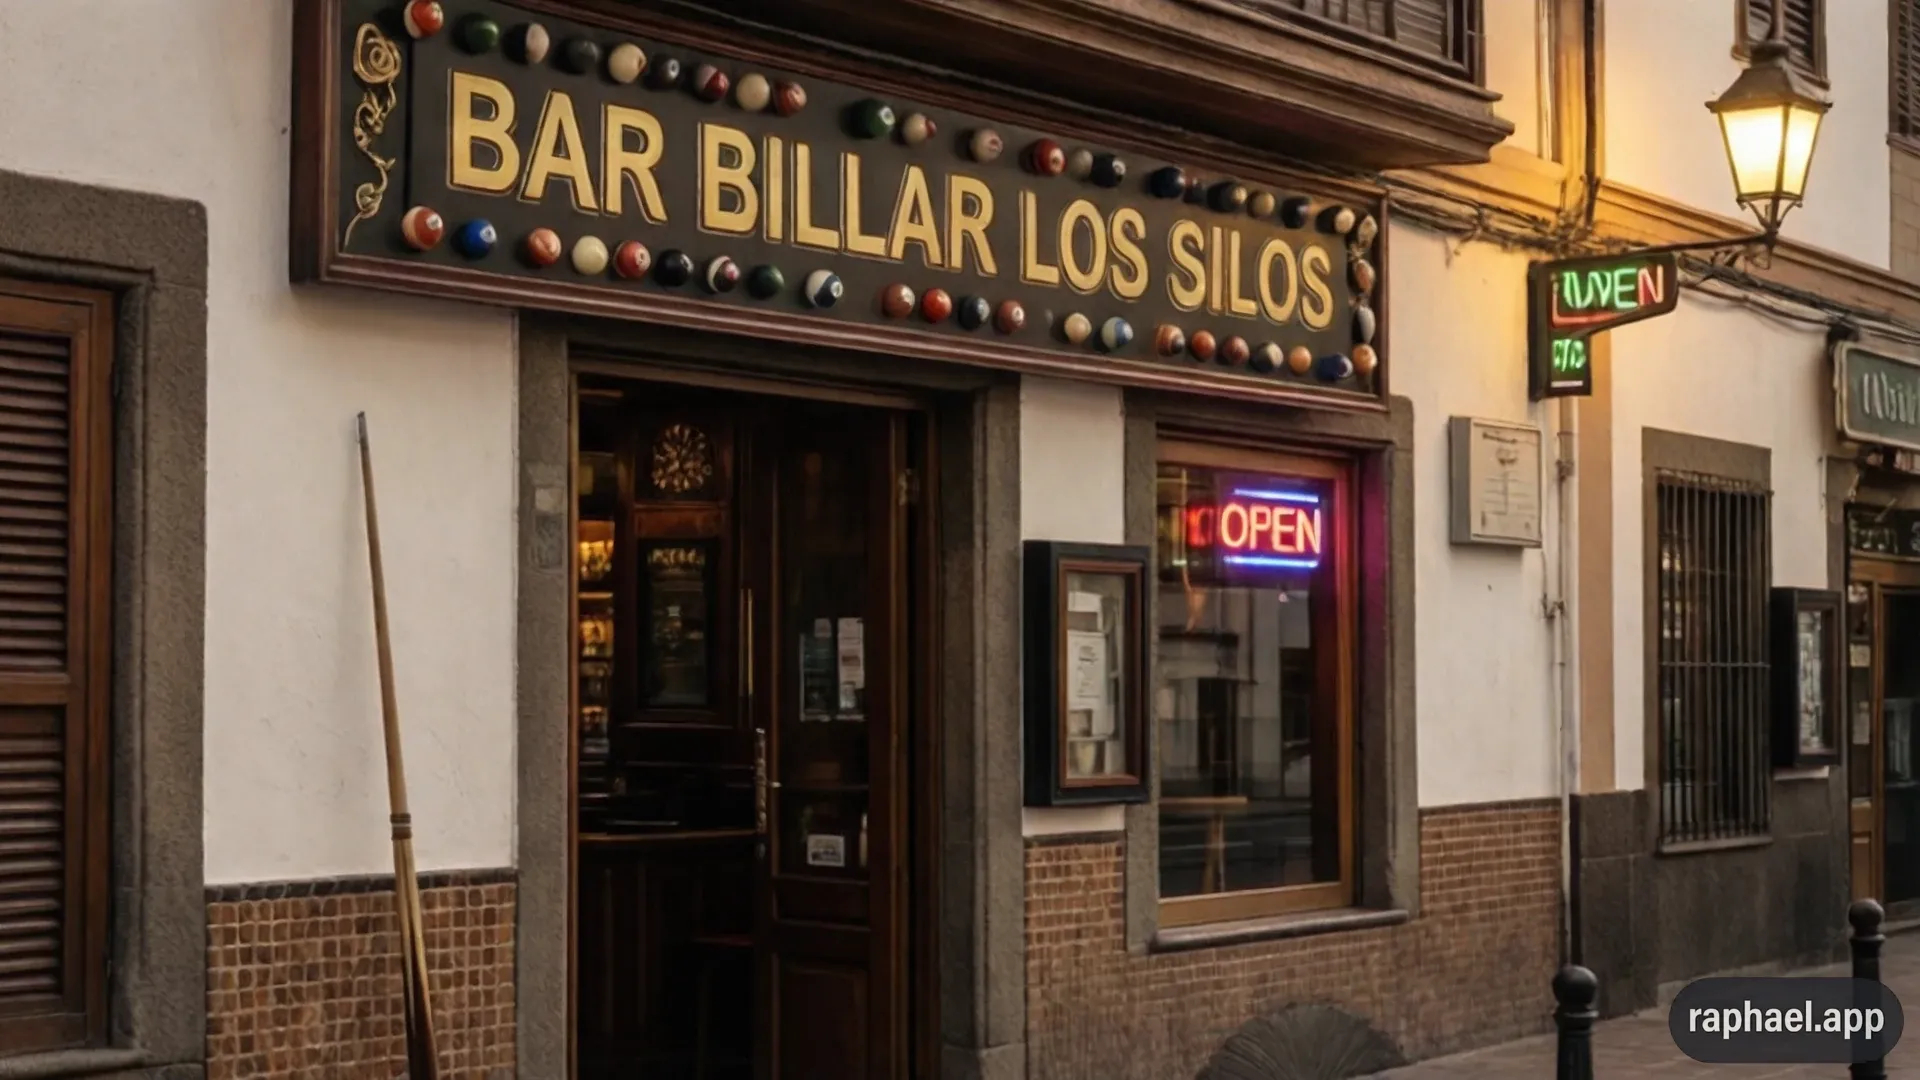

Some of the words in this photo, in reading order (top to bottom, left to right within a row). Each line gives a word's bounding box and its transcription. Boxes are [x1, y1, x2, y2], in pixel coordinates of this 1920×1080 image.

[446, 68, 668, 224] BAR
[697, 121, 997, 277] BILLAR
[1020, 189, 1150, 302] LOS
[1166, 218, 1335, 332] SILOS
[1220, 502, 1322, 555] OPEN
